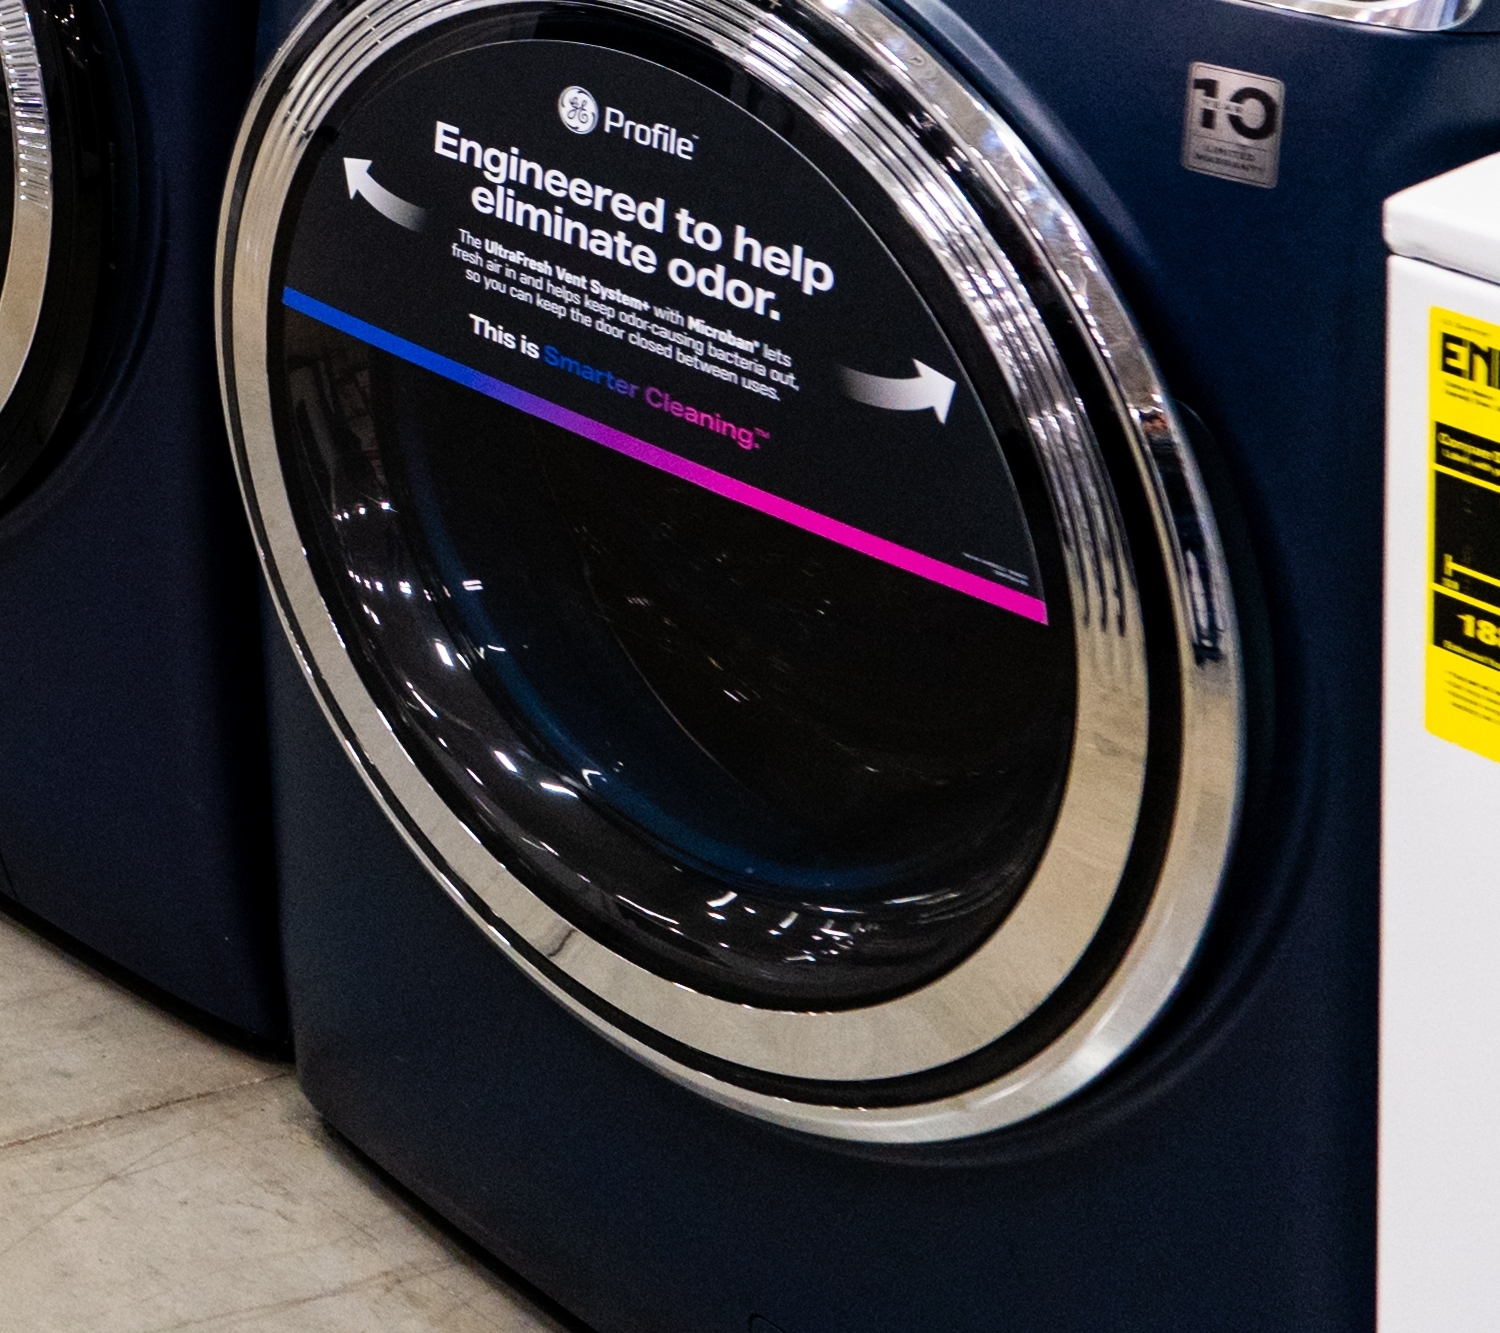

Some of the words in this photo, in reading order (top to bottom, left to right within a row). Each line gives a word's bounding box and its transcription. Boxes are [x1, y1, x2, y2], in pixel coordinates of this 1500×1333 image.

[1192, 77, 1278, 142] 10
[1203, 143, 1256, 165] LIMITED
[434, 121, 666, 234] Engineered
[674, 207, 723, 253] to
[734, 226, 835, 297] help
[471, 185, 658, 276] eliminate
[667, 251, 781, 322] odor.
[451, 242, 482, 269] fresh
[484, 257, 504, 277] air
[505, 262, 518, 281] in
[519, 268, 545, 292] and
[546, 275, 583, 307] helps
[584, 290, 617, 322] keep
[618, 303, 705, 354] odor-causing
[707, 340, 767, 375] bacteria
[769, 362, 800, 392] out,
[458, 228, 482, 249] The
[484, 238, 553, 278] UltraFresh
[555, 263, 588, 290] Vent
[589, 277, 652, 313] System+
[653, 304, 685, 327] with
[763, 340, 792, 368] lets
[465, 267, 481, 284] so
[483, 274, 507, 301] you
[509, 282, 533, 303] can
[536, 292, 568, 323] keep
[570, 303, 593, 324] the
[595, 311, 625, 336] door
[628, 323, 673, 358] closed
[675, 341, 739, 384] between
[740, 376, 781, 402] uses.
[468, 313, 518, 350] This
[520, 333, 540, 360] is
[543, 345, 643, 399] Smarter
